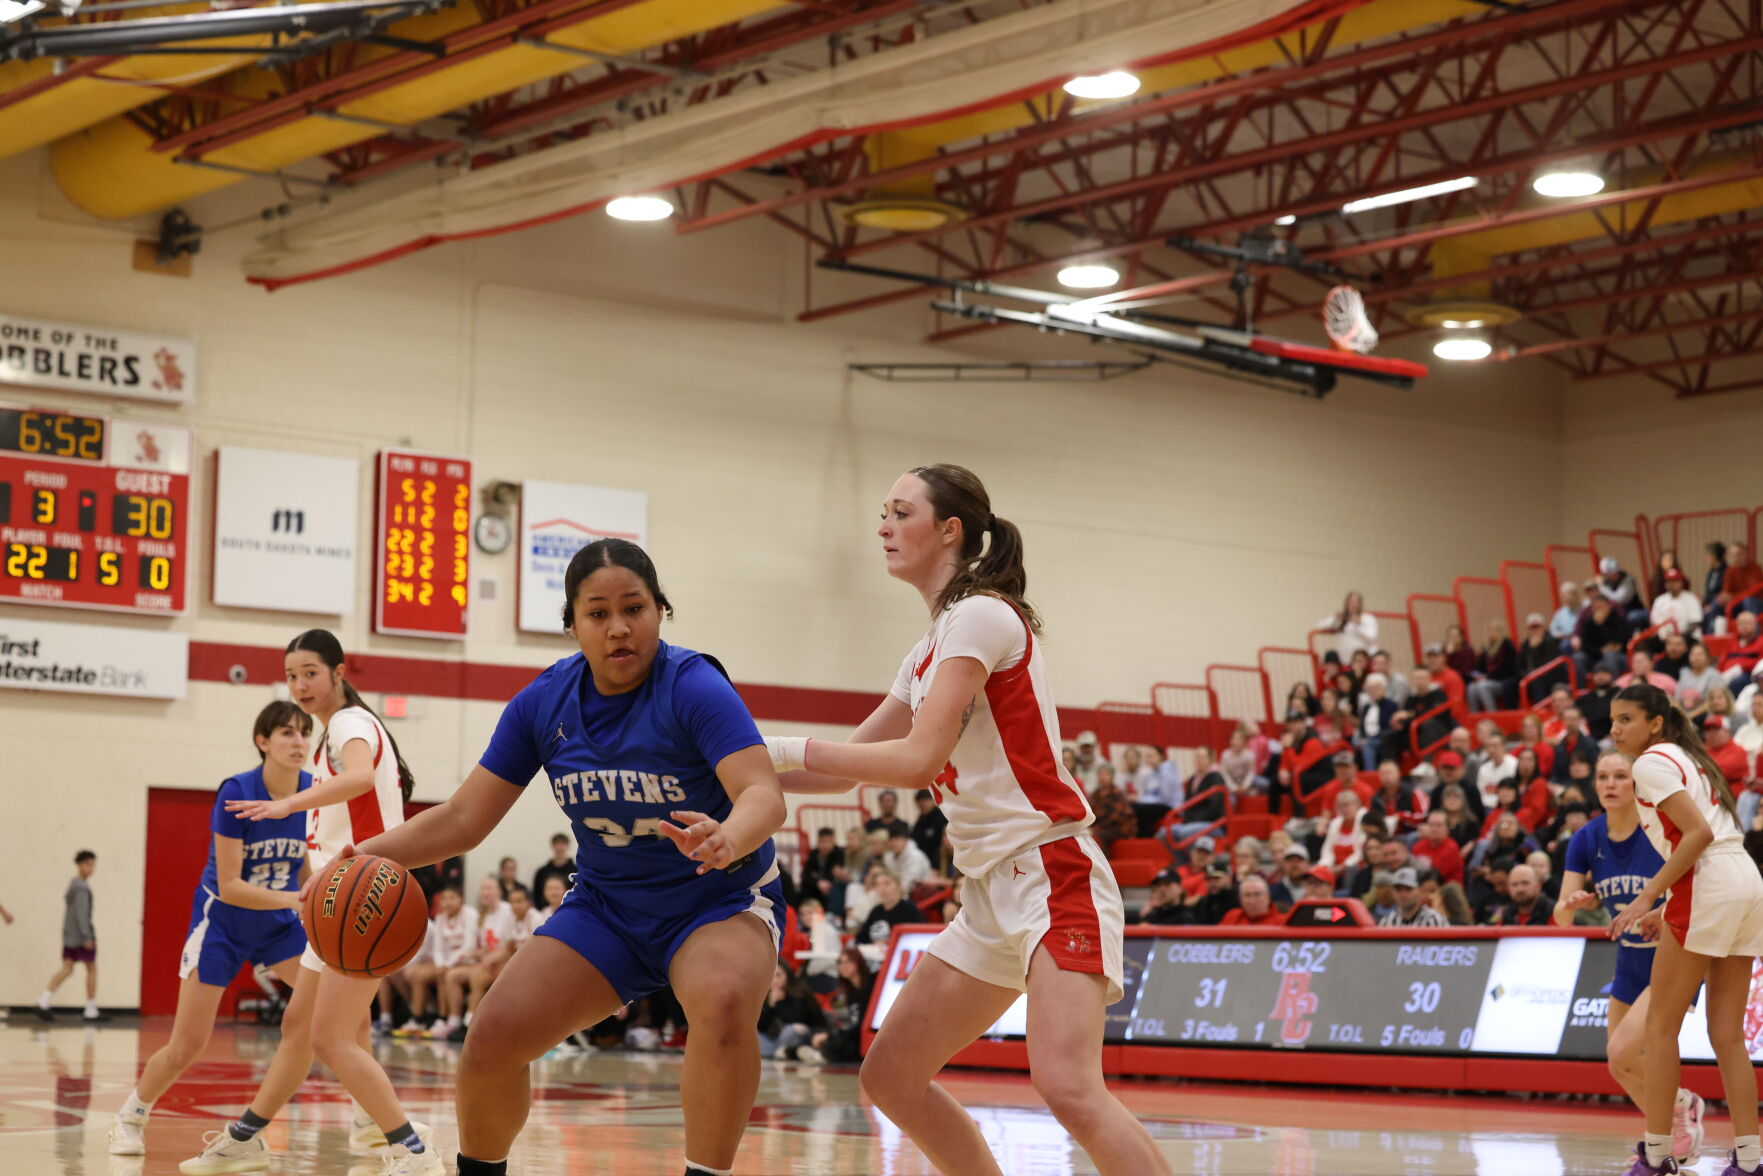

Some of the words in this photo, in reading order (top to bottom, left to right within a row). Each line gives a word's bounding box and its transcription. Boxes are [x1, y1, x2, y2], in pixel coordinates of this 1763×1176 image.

[51, 330, 75, 344] OF
[85, 335, 119, 350] THE
[0, 344, 141, 386] BBLERS
[19, 412, 101, 459] 6:52
[115, 469, 172, 494] GUEST
[402, 478, 416, 502] 5
[421, 480, 436, 504] 2
[454, 484, 468, 508] 2
[36, 490, 55, 524] 3
[127, 496, 172, 539] 30
[394, 504, 416, 525] 11
[420, 505, 435, 529] 2
[387, 528, 415, 553] 22
[420, 531, 435, 555] 2
[7, 543, 47, 579] 22
[68, 550, 78, 580] 1
[99, 552, 119, 586] 5
[149, 556, 170, 591] 0
[386, 552, 414, 578] 23
[419, 555, 434, 579] 2
[387, 578, 414, 603] 34
[418, 582, 433, 606] 2
[0, 661, 97, 685] terstate
[554, 769, 687, 807] STEVENS
[353, 862, 401, 936] Baden
[1168, 943, 1256, 964] COBBLERS
[1271, 941, 1332, 972] 6:52
[1396, 945, 1478, 966] RAIDERS
[1194, 978, 1228, 1008] 31
[1403, 981, 1442, 1014] 30
[1181, 1019, 1195, 1040] 3
[1195, 1020, 1239, 1041] Fouls
[1254, 1020, 1265, 1042] 1
[1380, 1025, 1396, 1047] 5
[1398, 1025, 1446, 1047] Fouls
[1458, 1027, 1473, 1049] 0
